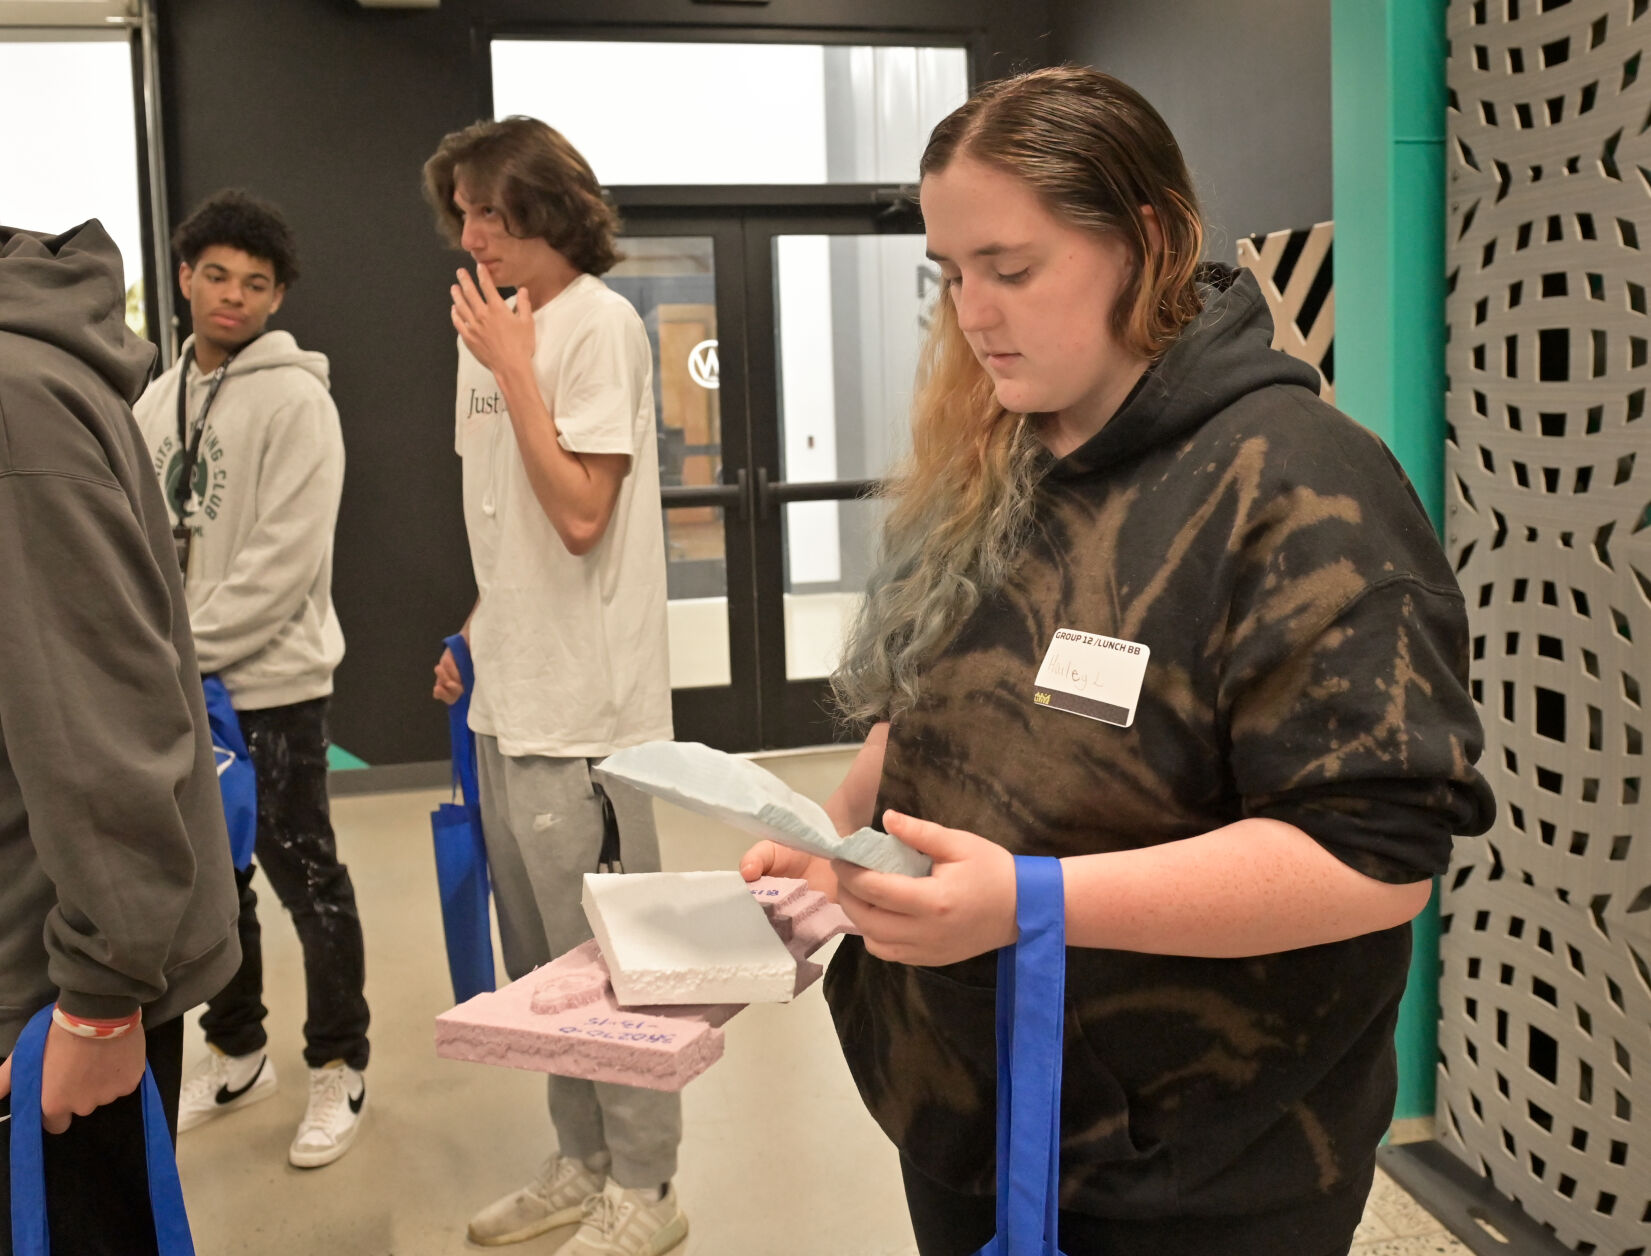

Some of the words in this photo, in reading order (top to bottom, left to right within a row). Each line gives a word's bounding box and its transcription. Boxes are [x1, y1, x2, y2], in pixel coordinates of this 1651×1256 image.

[466, 388, 500, 419] Just
[204, 469, 227, 520] CLUB
[1055, 631, 1081, 642] GROUP
[1082, 636, 1094, 645] 12
[1094, 638, 1126, 652] /LUNCH
[1127, 645, 1141, 655] BB
